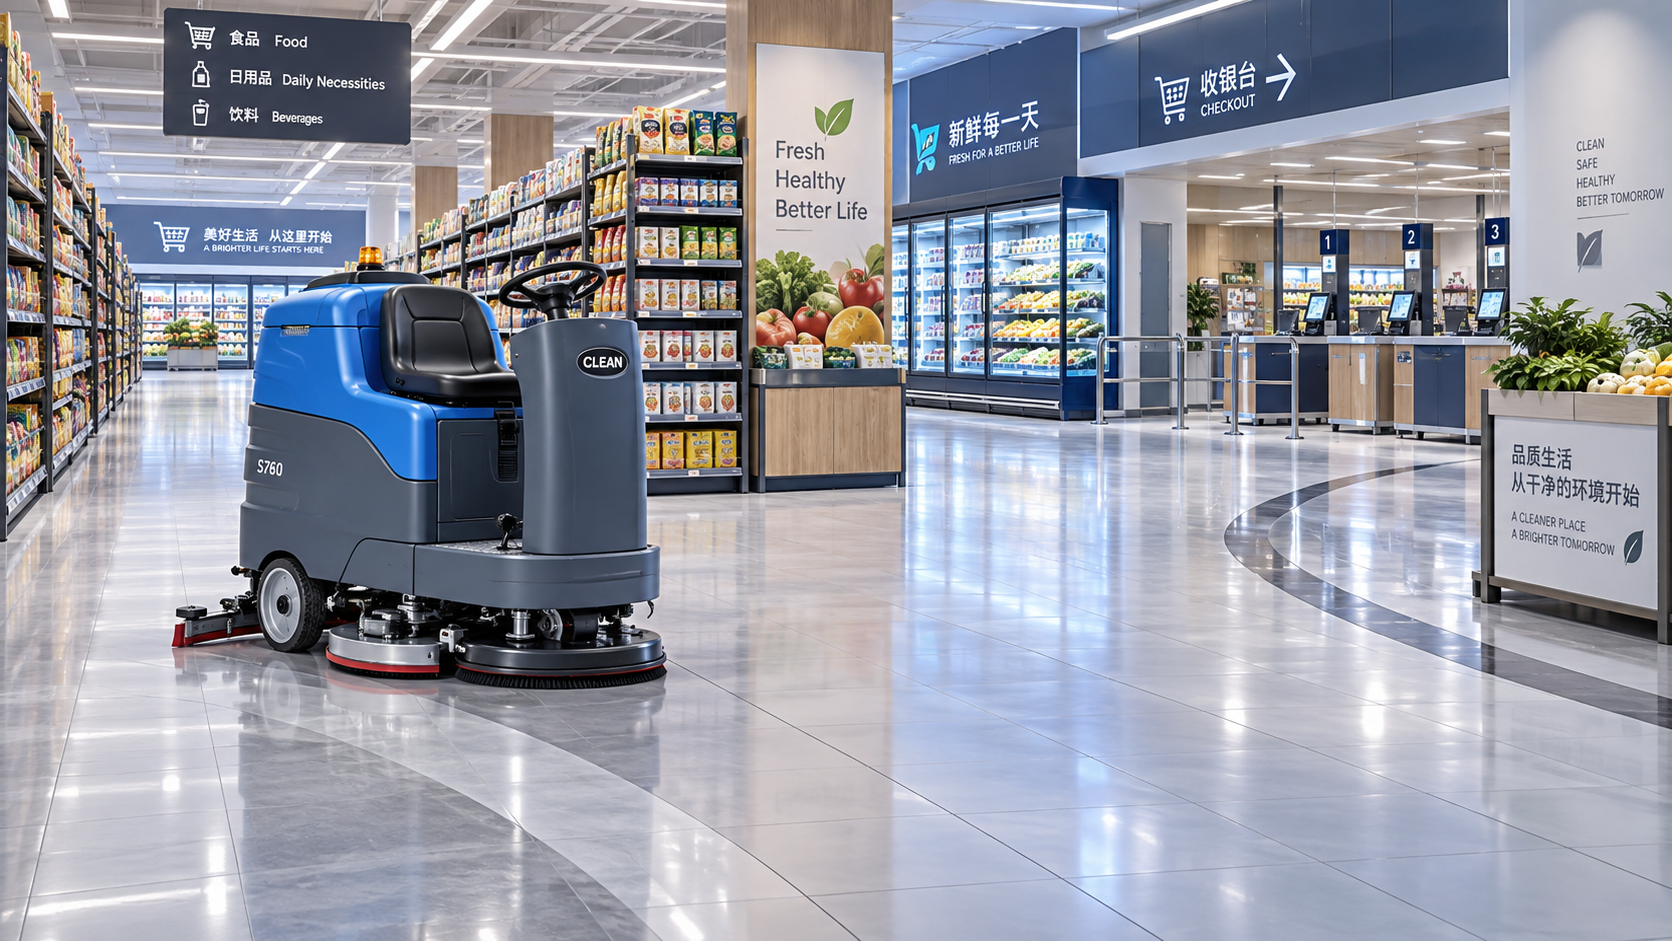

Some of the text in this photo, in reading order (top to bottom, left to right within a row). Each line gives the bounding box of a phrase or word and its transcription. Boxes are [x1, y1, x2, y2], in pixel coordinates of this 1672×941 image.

[229, 30, 260, 47] 食品
[275, 35, 308, 48] Food
[230, 69, 272, 86] 日用品
[282, 74, 386, 90] Daily Necessities
[1200, 61, 1256, 98] 收银台
[1200, 93, 1256, 117] CHECKOUT
[229, 107, 259, 123] 饮料
[272, 111, 323, 126] Beverages
[948, 100, 1039, 148] 新鲜每一天
[776, 140, 825, 160] Fresh
[949, 137, 1039, 165] FRESH FOR A BETTER LIFE
[1576, 138, 1605, 152] CLEAN
[1576, 157, 1598, 171] SAFE
[776, 169, 846, 195] Healthy
[1576, 174, 1616, 189] HEALTHY
[1576, 188, 1665, 207] BETTER TOMORROW
[776, 199, 868, 220] Better Life
[203, 227, 333, 244] 美好生活 从这里开始
[1408, 229, 1415, 245] 2
[1491, 224, 1499, 240] 3
[203, 244, 210, 252] A
[253, 245, 270, 253] LIFE
[272, 245, 302, 254] STARTS
[1325, 235, 1330, 250] 1
[583, 356, 623, 368] CLEAN
[1511, 444, 1572, 471] 品质生活
[257, 459, 283, 476] S760
[1511, 471, 1640, 508] 从干净的环境开始
[1511, 511, 1586, 532] A CLEANER PLACE
[1511, 529, 1517, 539] A
[1519, 530, 1558, 546] BRIGHTER
